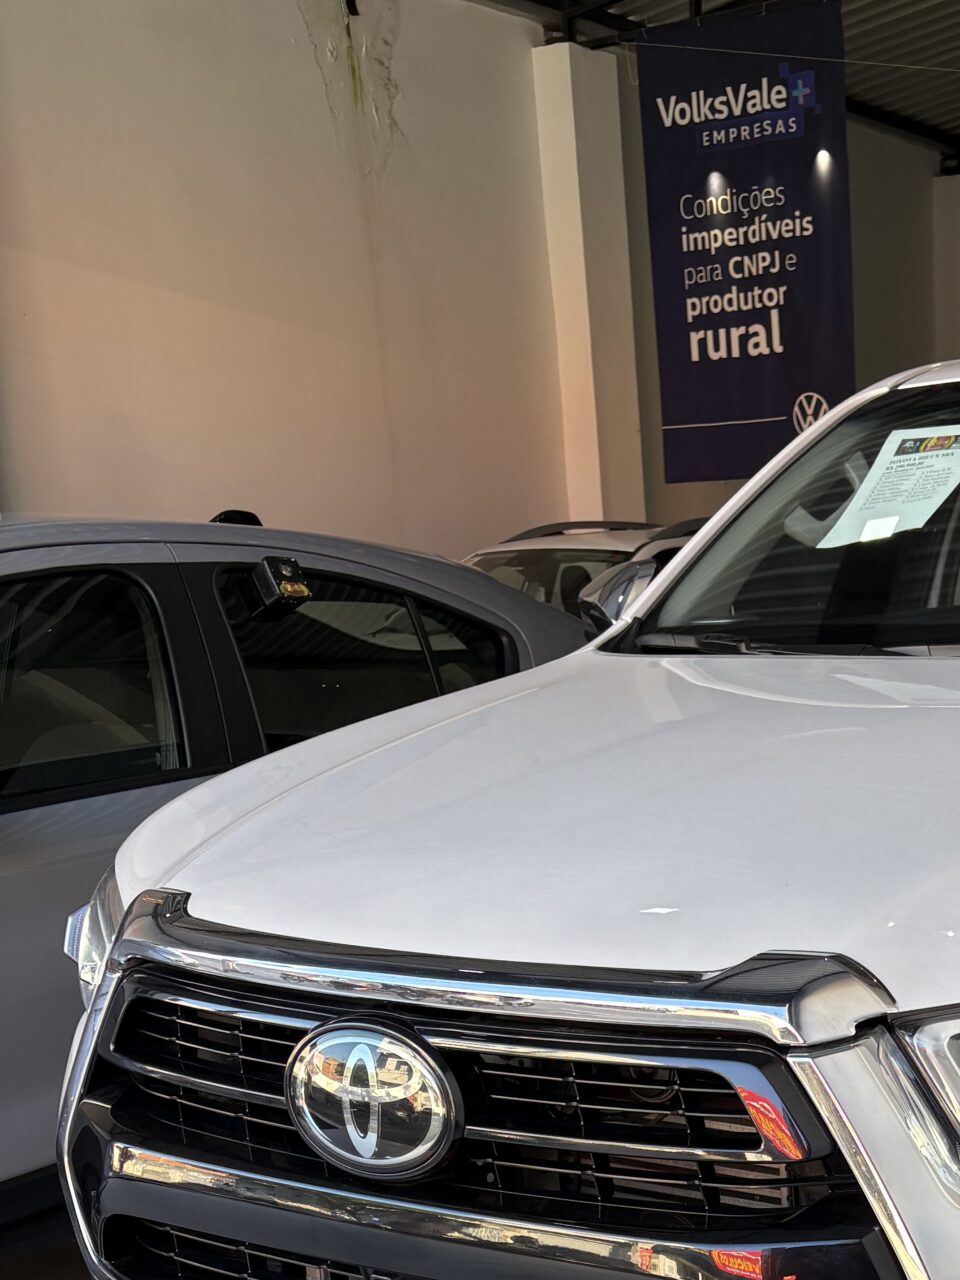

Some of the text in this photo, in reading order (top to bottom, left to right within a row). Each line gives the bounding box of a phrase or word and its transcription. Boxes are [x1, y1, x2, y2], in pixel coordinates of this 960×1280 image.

[702, 117, 797, 146] EMPRESAS
[680, 186, 785, 219] Condições
[681, 210, 814, 255] imperdíveis
[684, 250, 797, 290] para CNPJ e
[686, 285, 787, 323] produtor
[689, 309, 784, 362] rural
